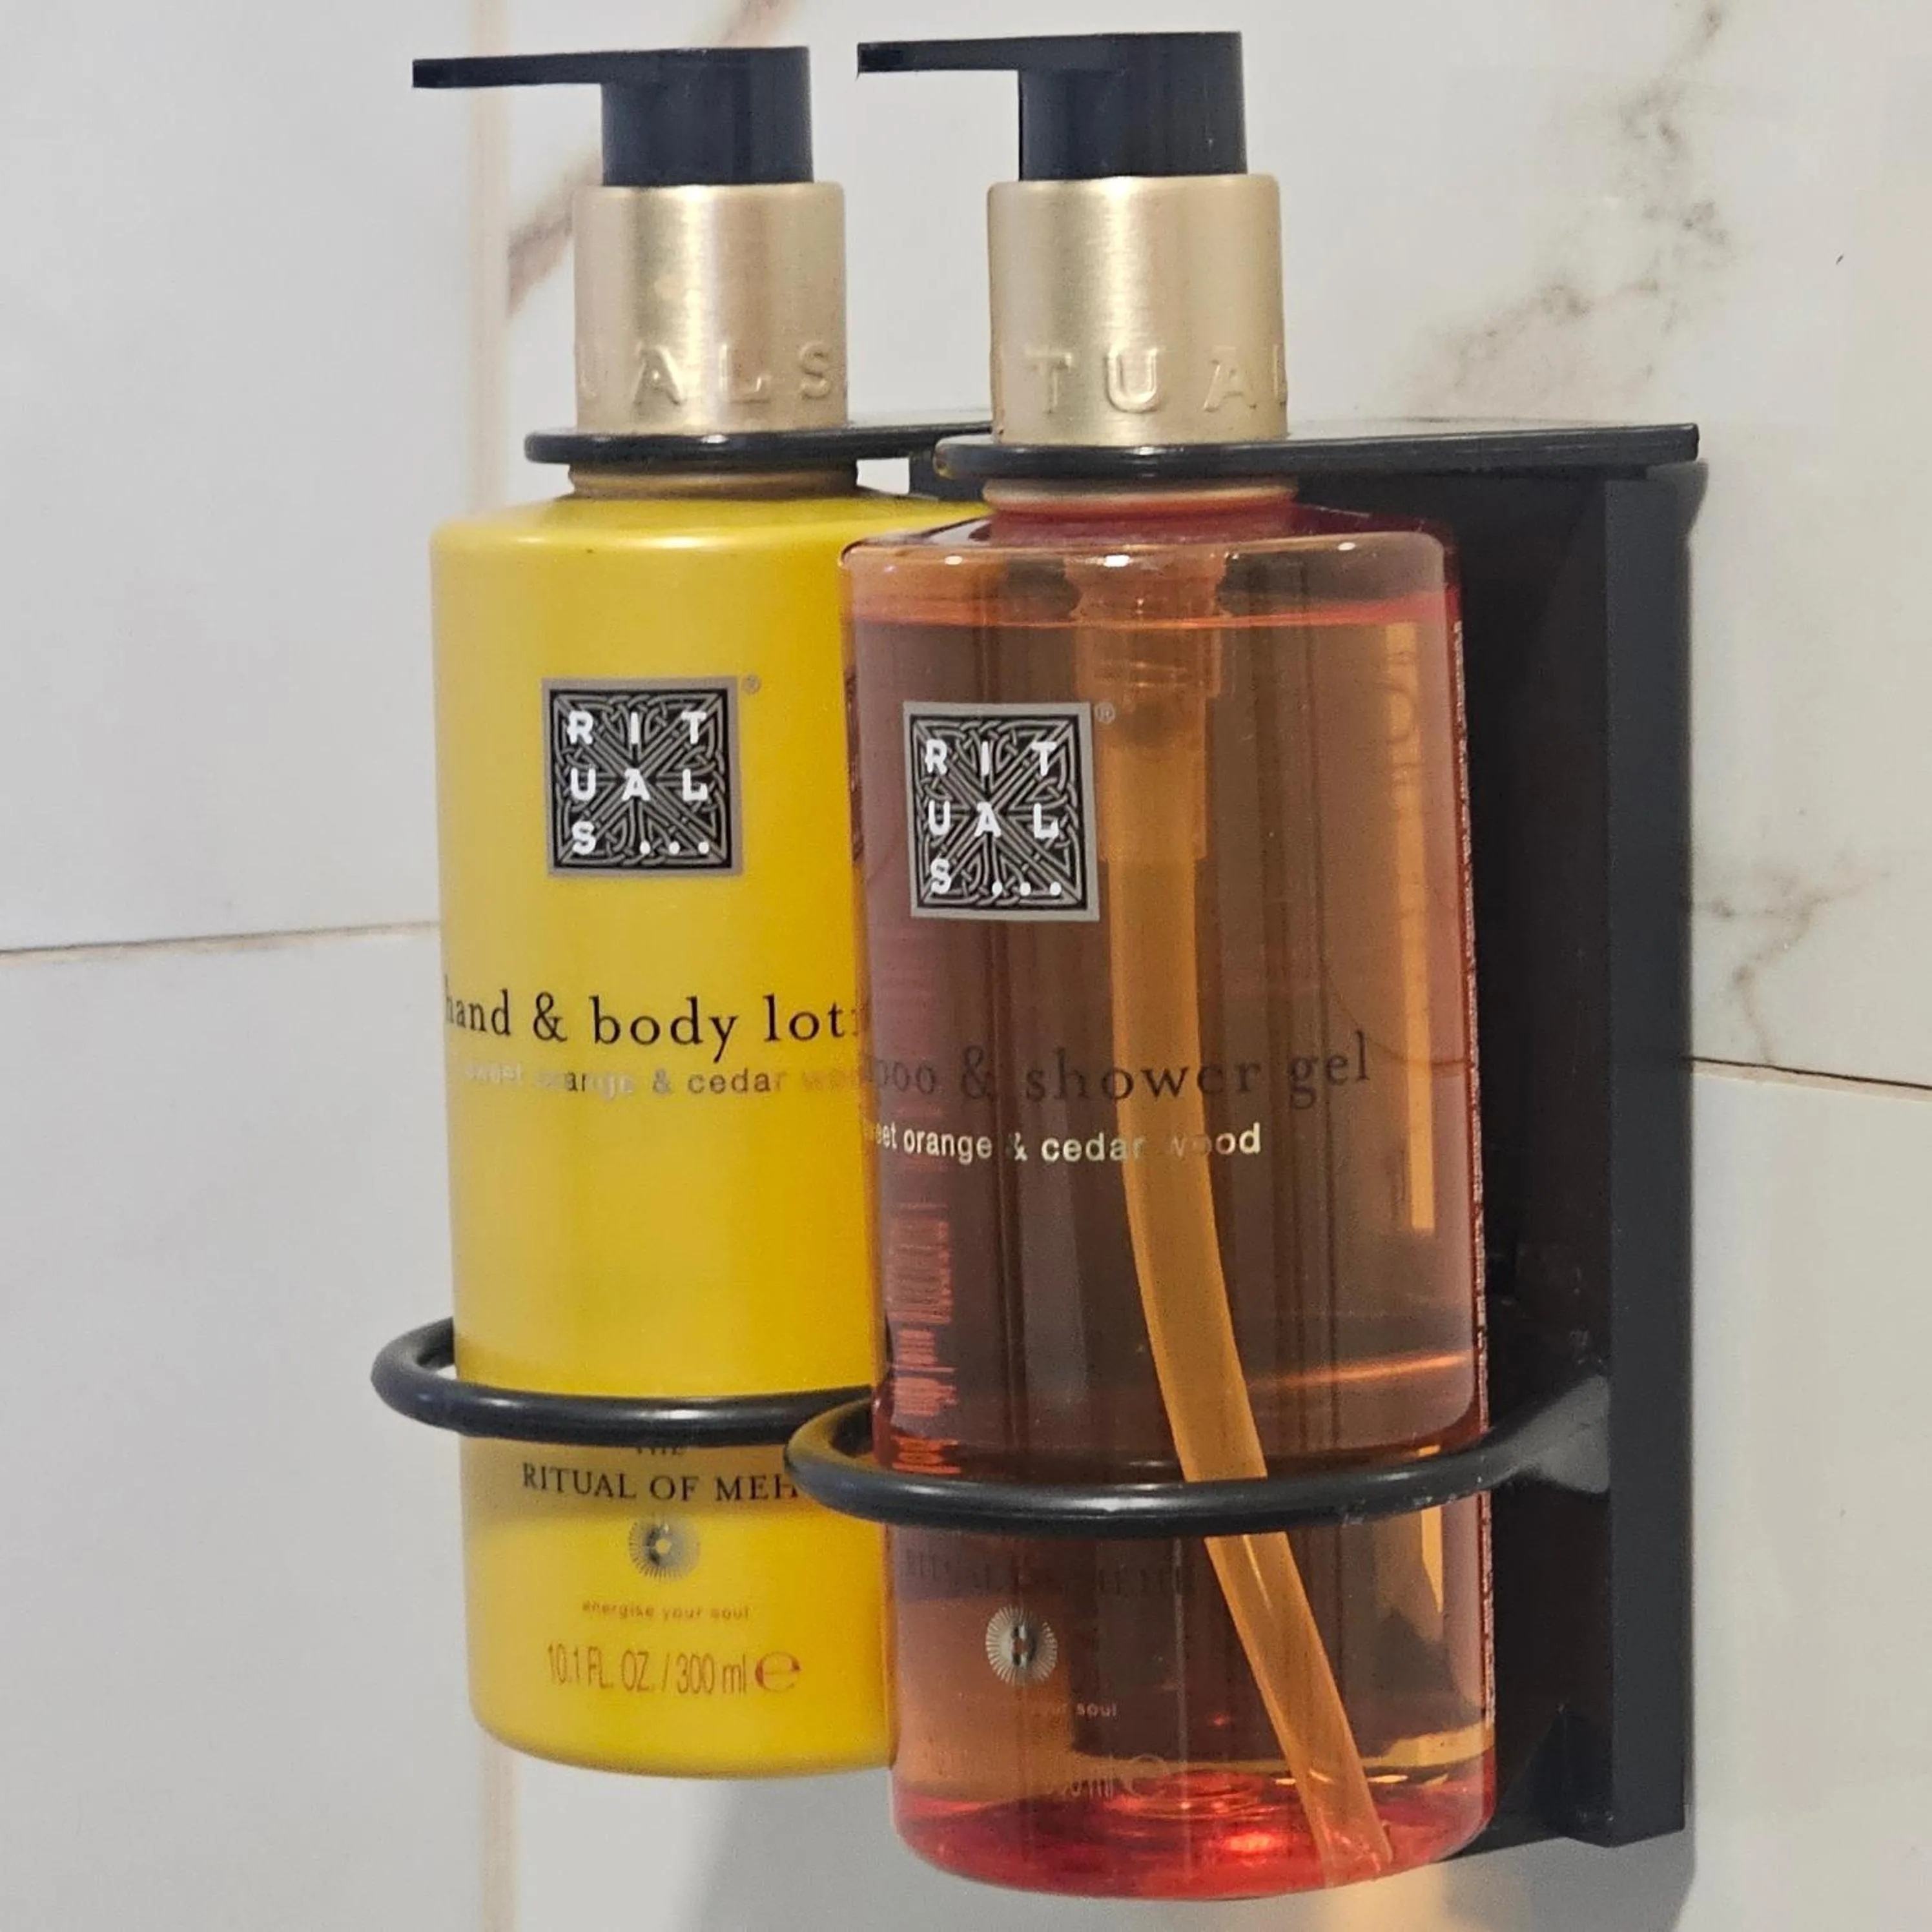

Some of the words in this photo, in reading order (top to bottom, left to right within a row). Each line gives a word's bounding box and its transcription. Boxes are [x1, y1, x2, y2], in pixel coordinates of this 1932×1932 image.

[444, 974, 510, 1037] hand
[533, 991, 568, 1042] &
[588, 994, 737, 1063] body
[763, 992, 861, 1042] lot
[652, 1068, 672, 1094] &
[688, 1068, 786, 1094] cedar
[1026, 1047, 1260, 1102] shower
[1290, 1031, 1370, 1109] gel
[903, 1128, 992, 1165] orange
[1041, 1132, 1147, 1162] cedar
[522, 1462, 637, 1499] RITUAL
[649, 1475, 700, 1501] OF
[715, 1473, 799, 1502] MEH
[663, 1605, 701, 1621] your
